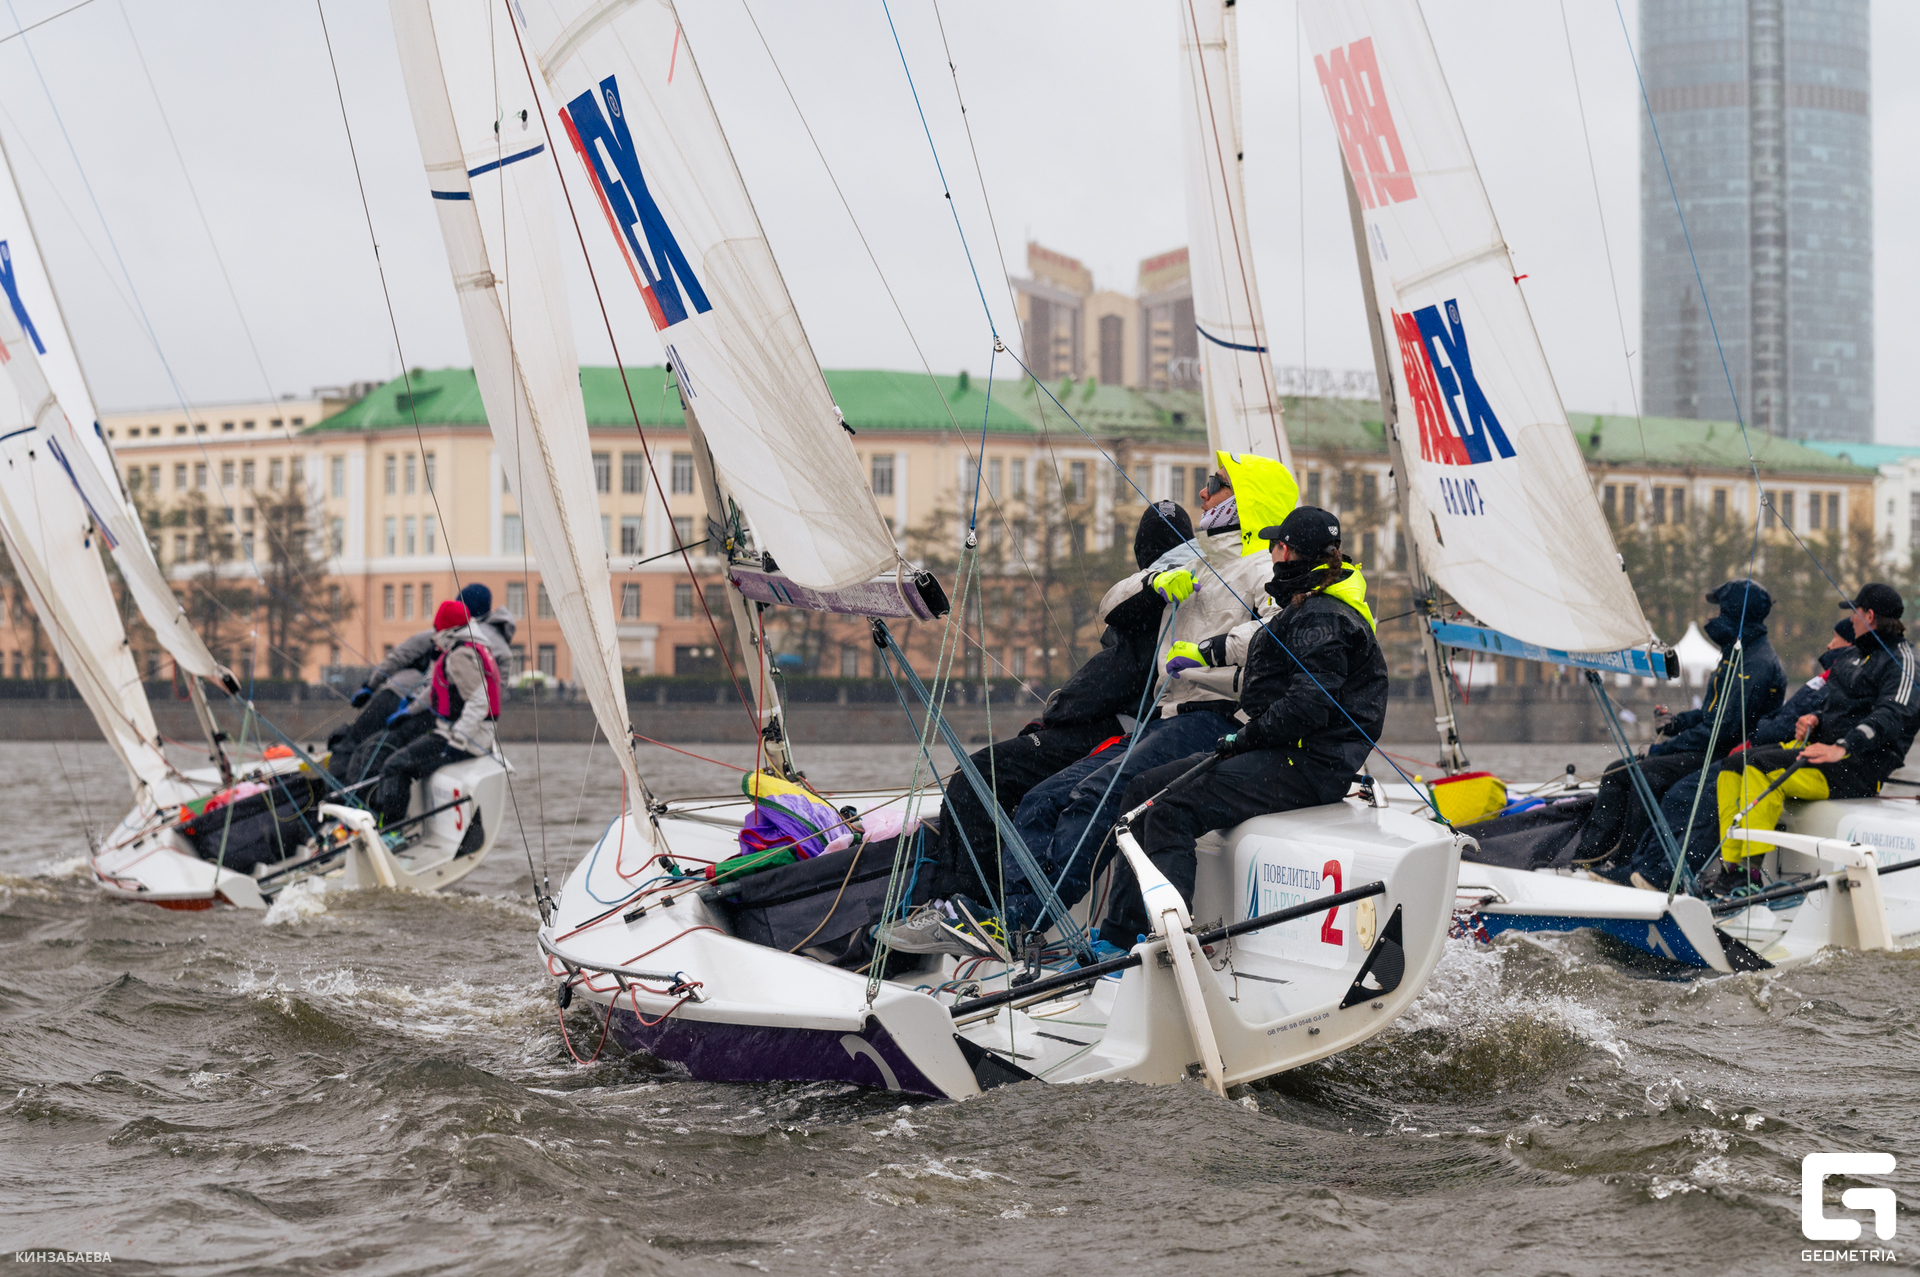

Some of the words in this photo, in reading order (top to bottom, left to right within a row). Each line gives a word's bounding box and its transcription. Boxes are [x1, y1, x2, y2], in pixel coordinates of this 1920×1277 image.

[1862, 831, 1916, 851] ПОВЕЛИТЕЛЬ
[1264, 864, 1320, 890] ПОВЕЛИТЕЛЬ
[1322, 860, 1343, 946] 2
